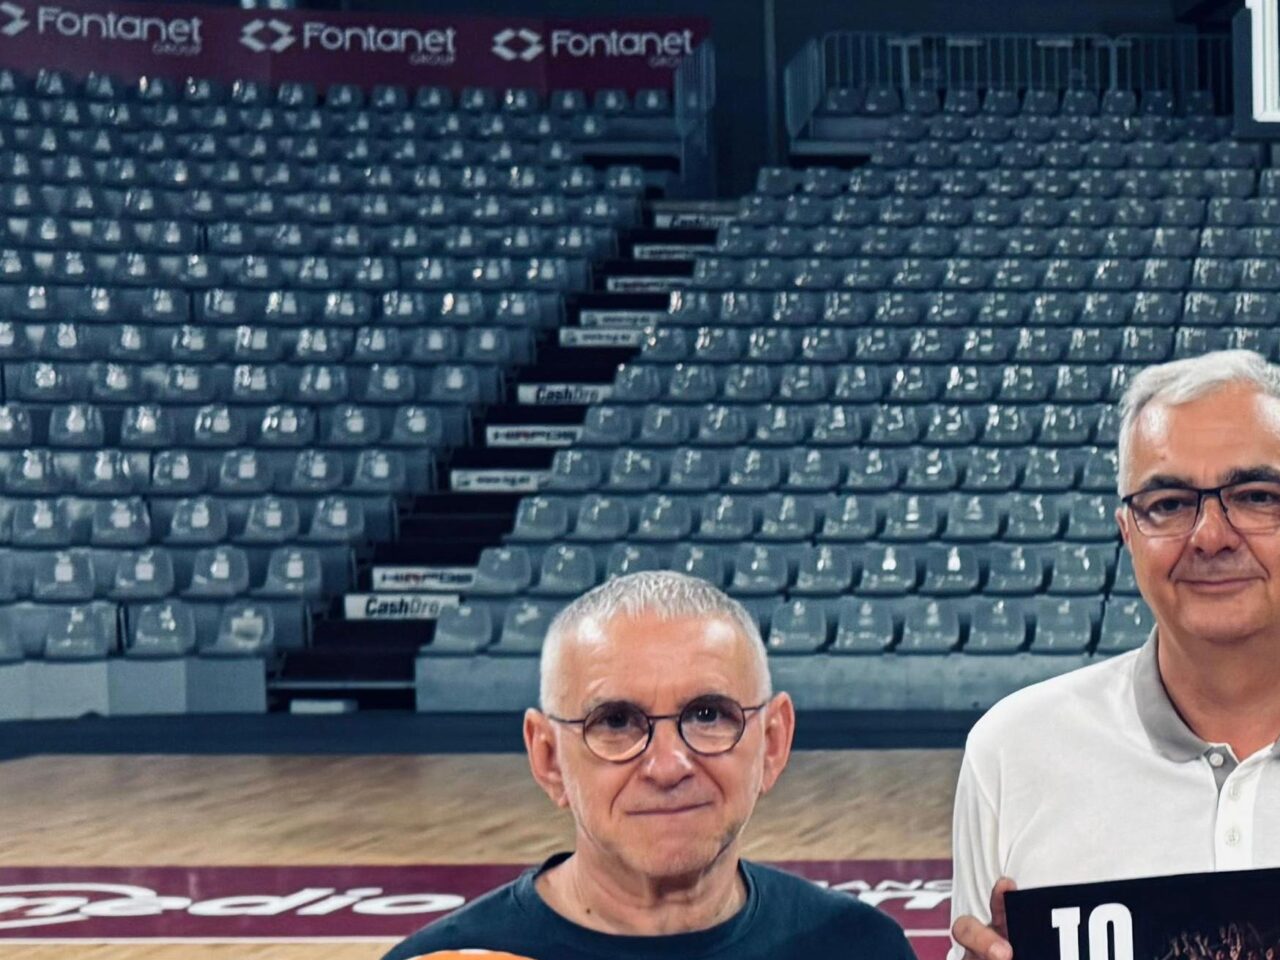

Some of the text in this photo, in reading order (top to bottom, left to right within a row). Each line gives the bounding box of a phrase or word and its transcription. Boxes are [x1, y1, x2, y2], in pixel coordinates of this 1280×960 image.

[37, 6, 202, 43] Fontanet
[303, 22, 456, 55] Fontanet
[551, 30, 693, 57] Fontanet
